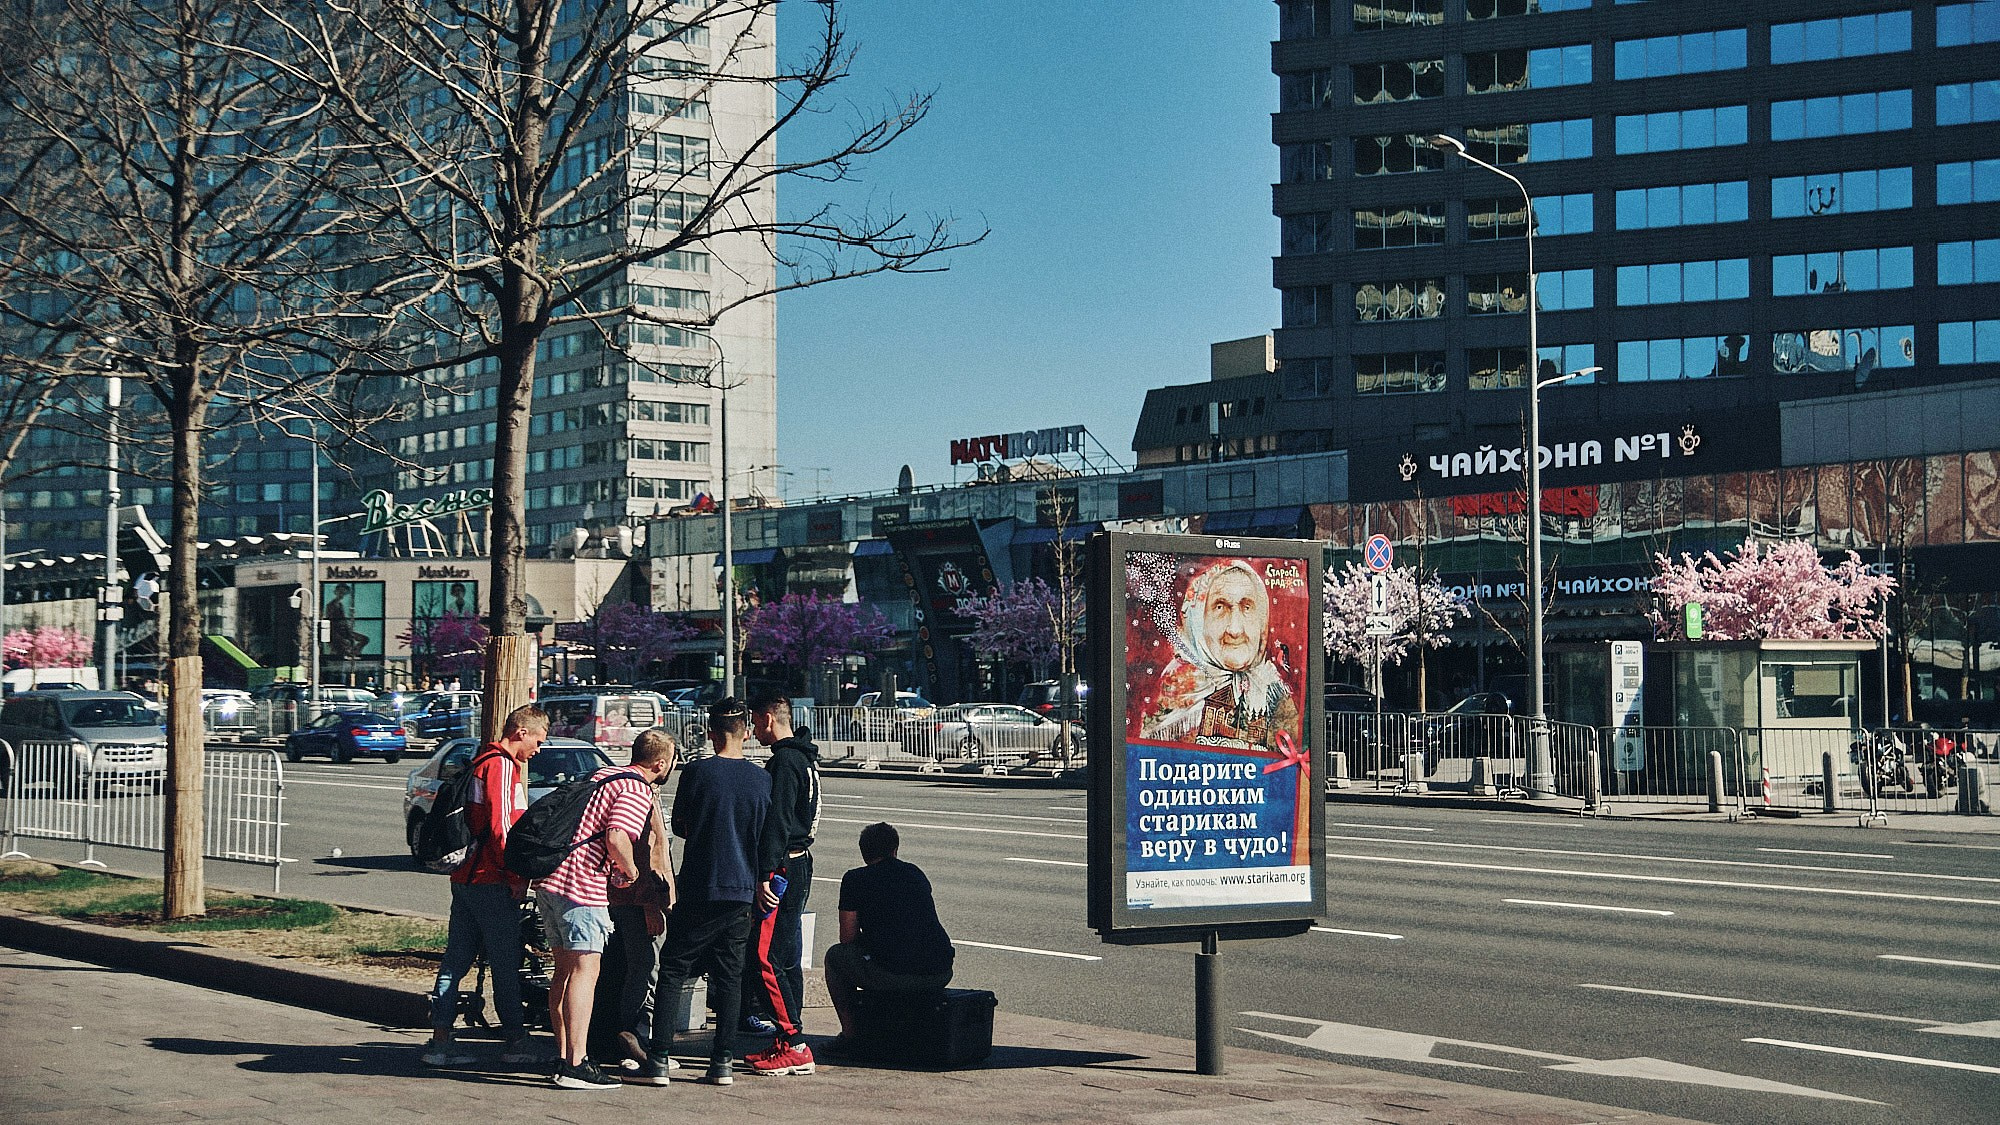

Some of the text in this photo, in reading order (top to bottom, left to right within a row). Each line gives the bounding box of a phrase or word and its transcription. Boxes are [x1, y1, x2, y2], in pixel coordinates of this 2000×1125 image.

[1429, 440, 1602, 478] ЧАЙХОНА
[1139, 758, 1257, 785] Подарите
[1139, 787, 1265, 810] одиноким
[1139, 812, 1258, 836] старикам
[1141, 831, 1287, 863] веру в чудо!
[1135, 871, 1306, 889] Узнайте, как помочь: www.starikam.org
